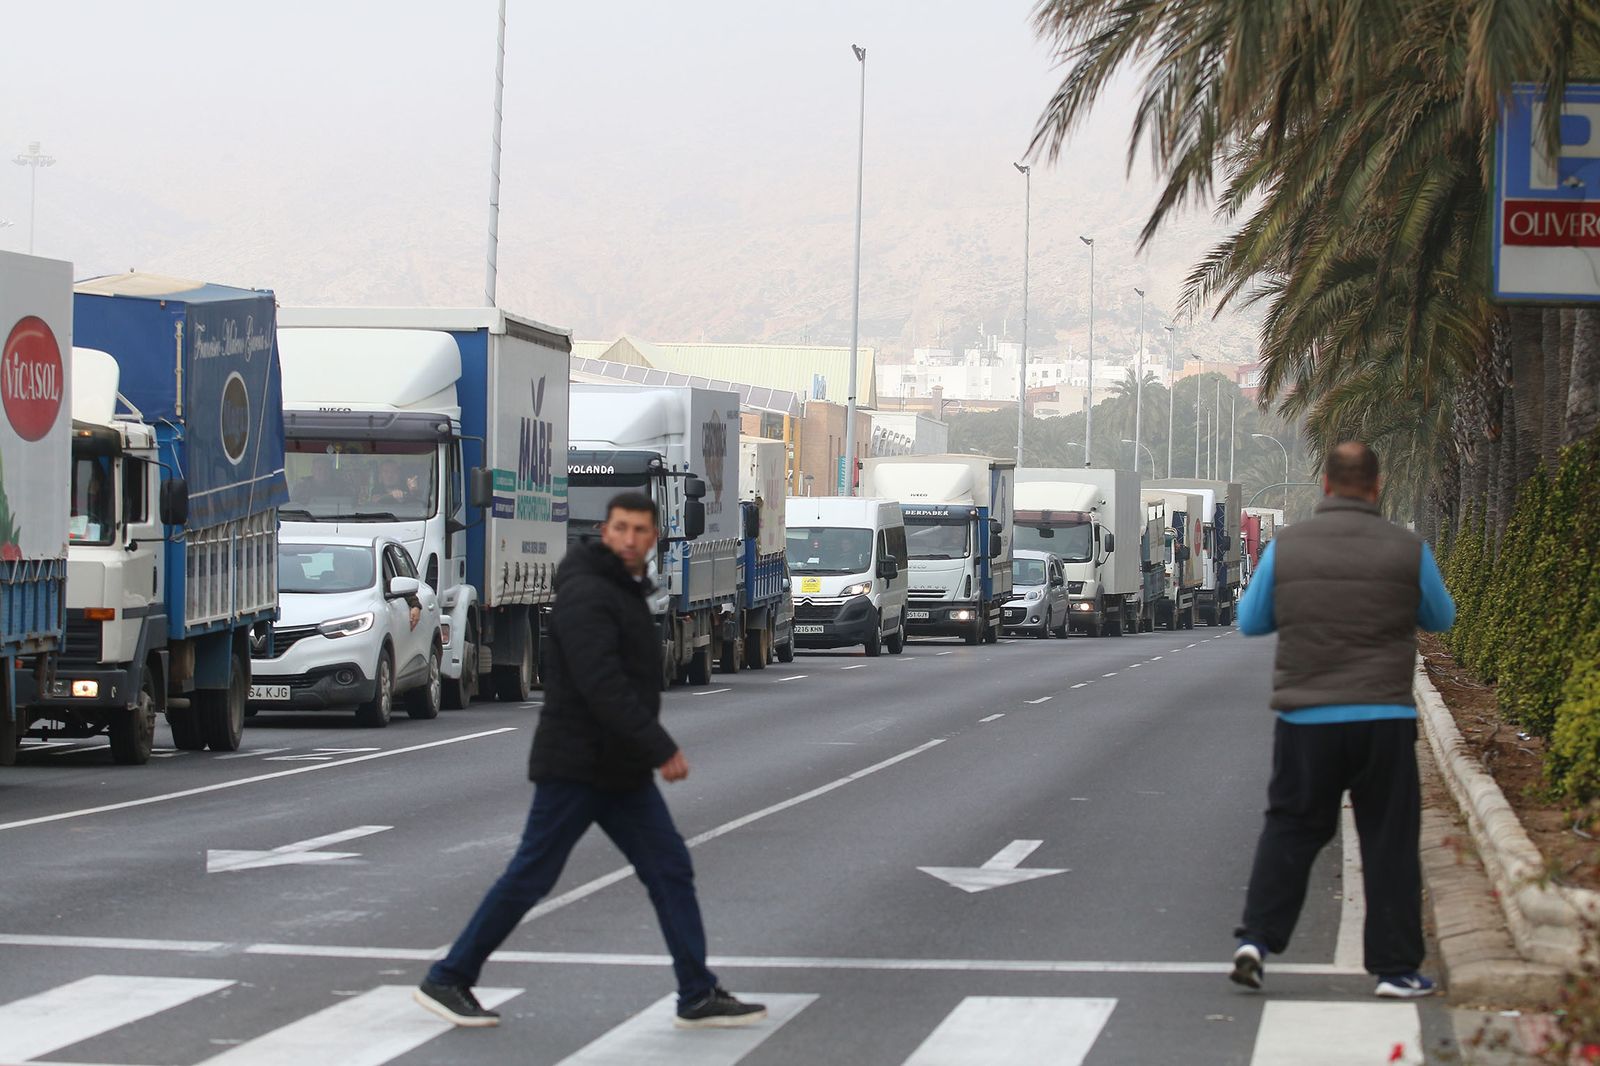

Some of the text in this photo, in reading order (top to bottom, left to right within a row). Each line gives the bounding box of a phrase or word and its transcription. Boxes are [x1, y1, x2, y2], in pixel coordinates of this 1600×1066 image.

[1510, 210, 1600, 237] OLIVER
[518, 417, 552, 493] MABE
[567, 464, 615, 475] YOLANDA
[265, 687, 288, 698] KJG
